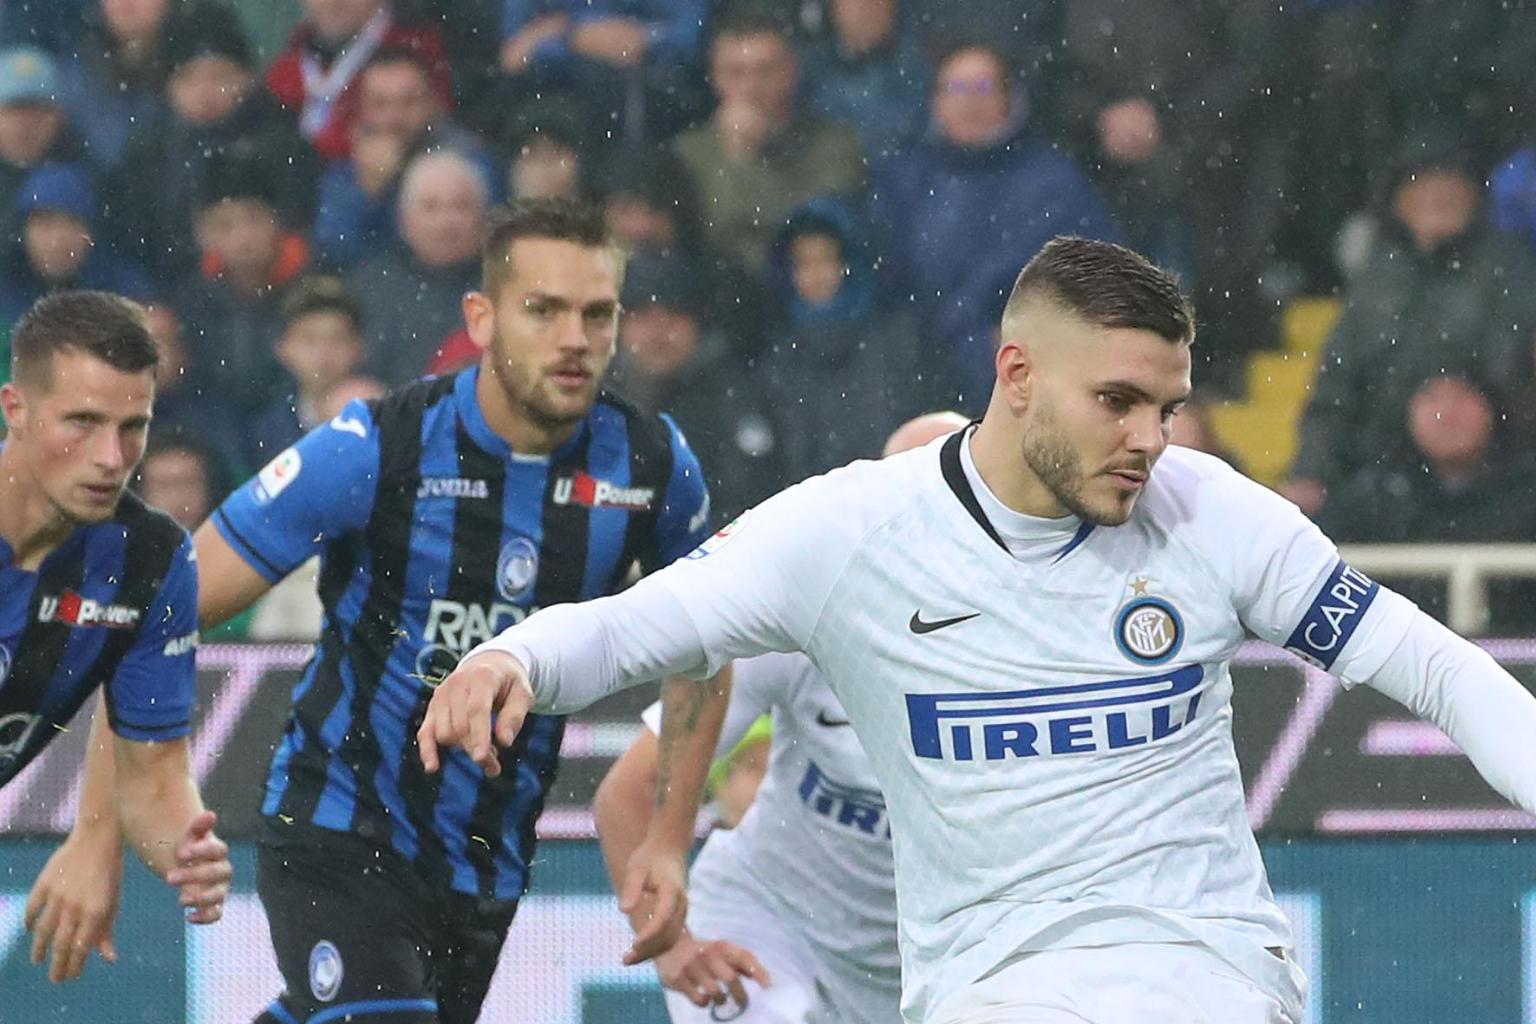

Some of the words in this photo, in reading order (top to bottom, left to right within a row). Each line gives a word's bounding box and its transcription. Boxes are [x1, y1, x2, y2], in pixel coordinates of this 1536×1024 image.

[423, 599, 542, 655] RAD
[1303, 565, 1373, 652] CAPIT
[904, 662, 1205, 762] PIRELLI
